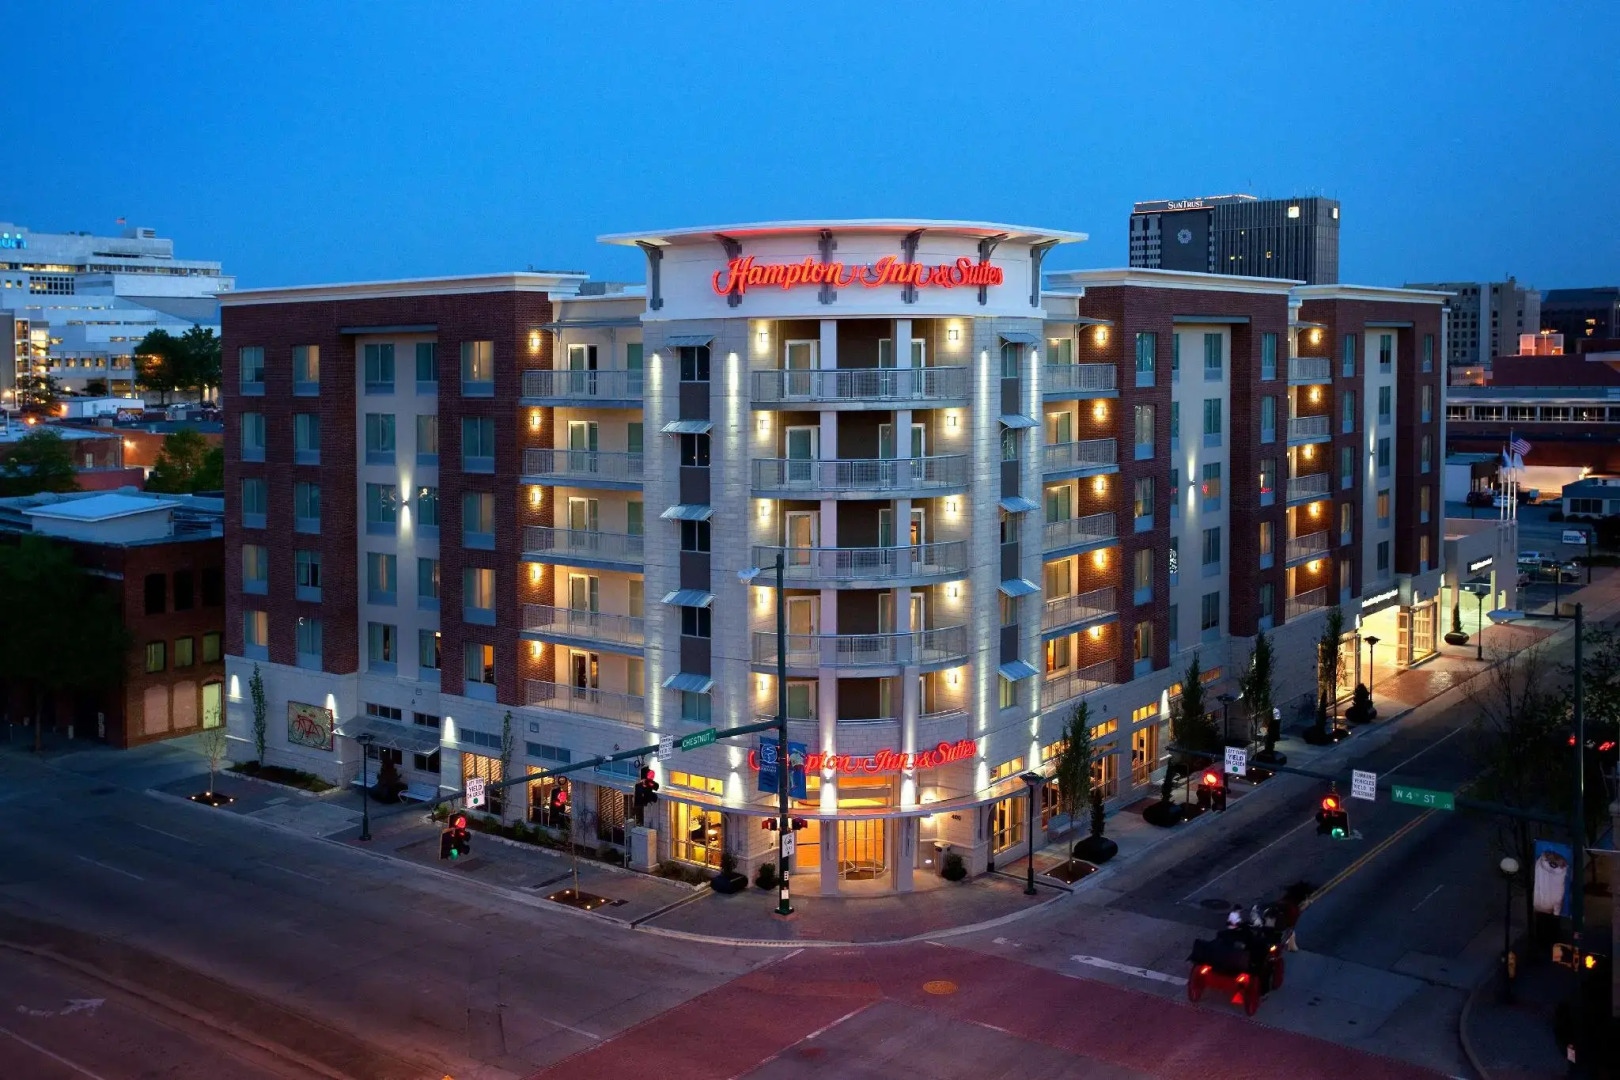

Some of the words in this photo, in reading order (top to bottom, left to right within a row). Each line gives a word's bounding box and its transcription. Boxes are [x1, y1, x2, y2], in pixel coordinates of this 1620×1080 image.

[712, 255, 858, 296] Hampton
[859, 255, 934, 288] Inn
[933, 263, 952, 288] &
[948, 256, 1004, 288] Suites
[682, 732, 710, 748] CHESTNUT
[862, 747, 917, 774] Inn
[931, 739, 977, 766] Suites
[1227, 753, 1244, 761] YIELD
[468, 784, 482, 792] YIELD
[1395, 789, 1404, 799] W
[1423, 794, 1436, 804] ST
